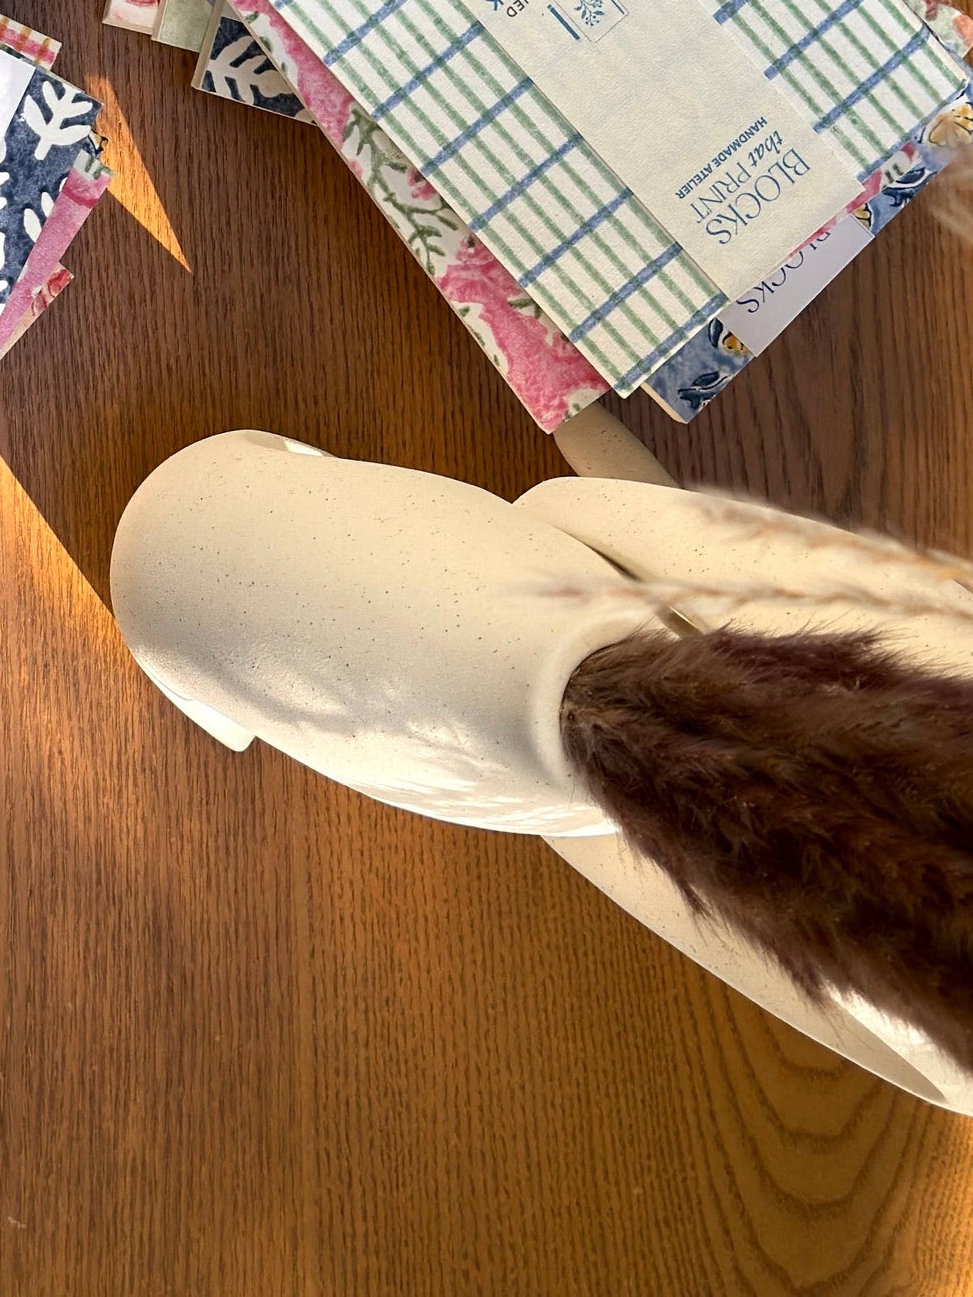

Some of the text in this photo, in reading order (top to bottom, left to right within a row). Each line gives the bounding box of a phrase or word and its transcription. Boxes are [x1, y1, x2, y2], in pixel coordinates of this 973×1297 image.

[675, 116, 768, 199] HANDMADE ATELIER
[690, 131, 783, 224] that PRINT
[705, 148, 811, 245] BLOCKS
